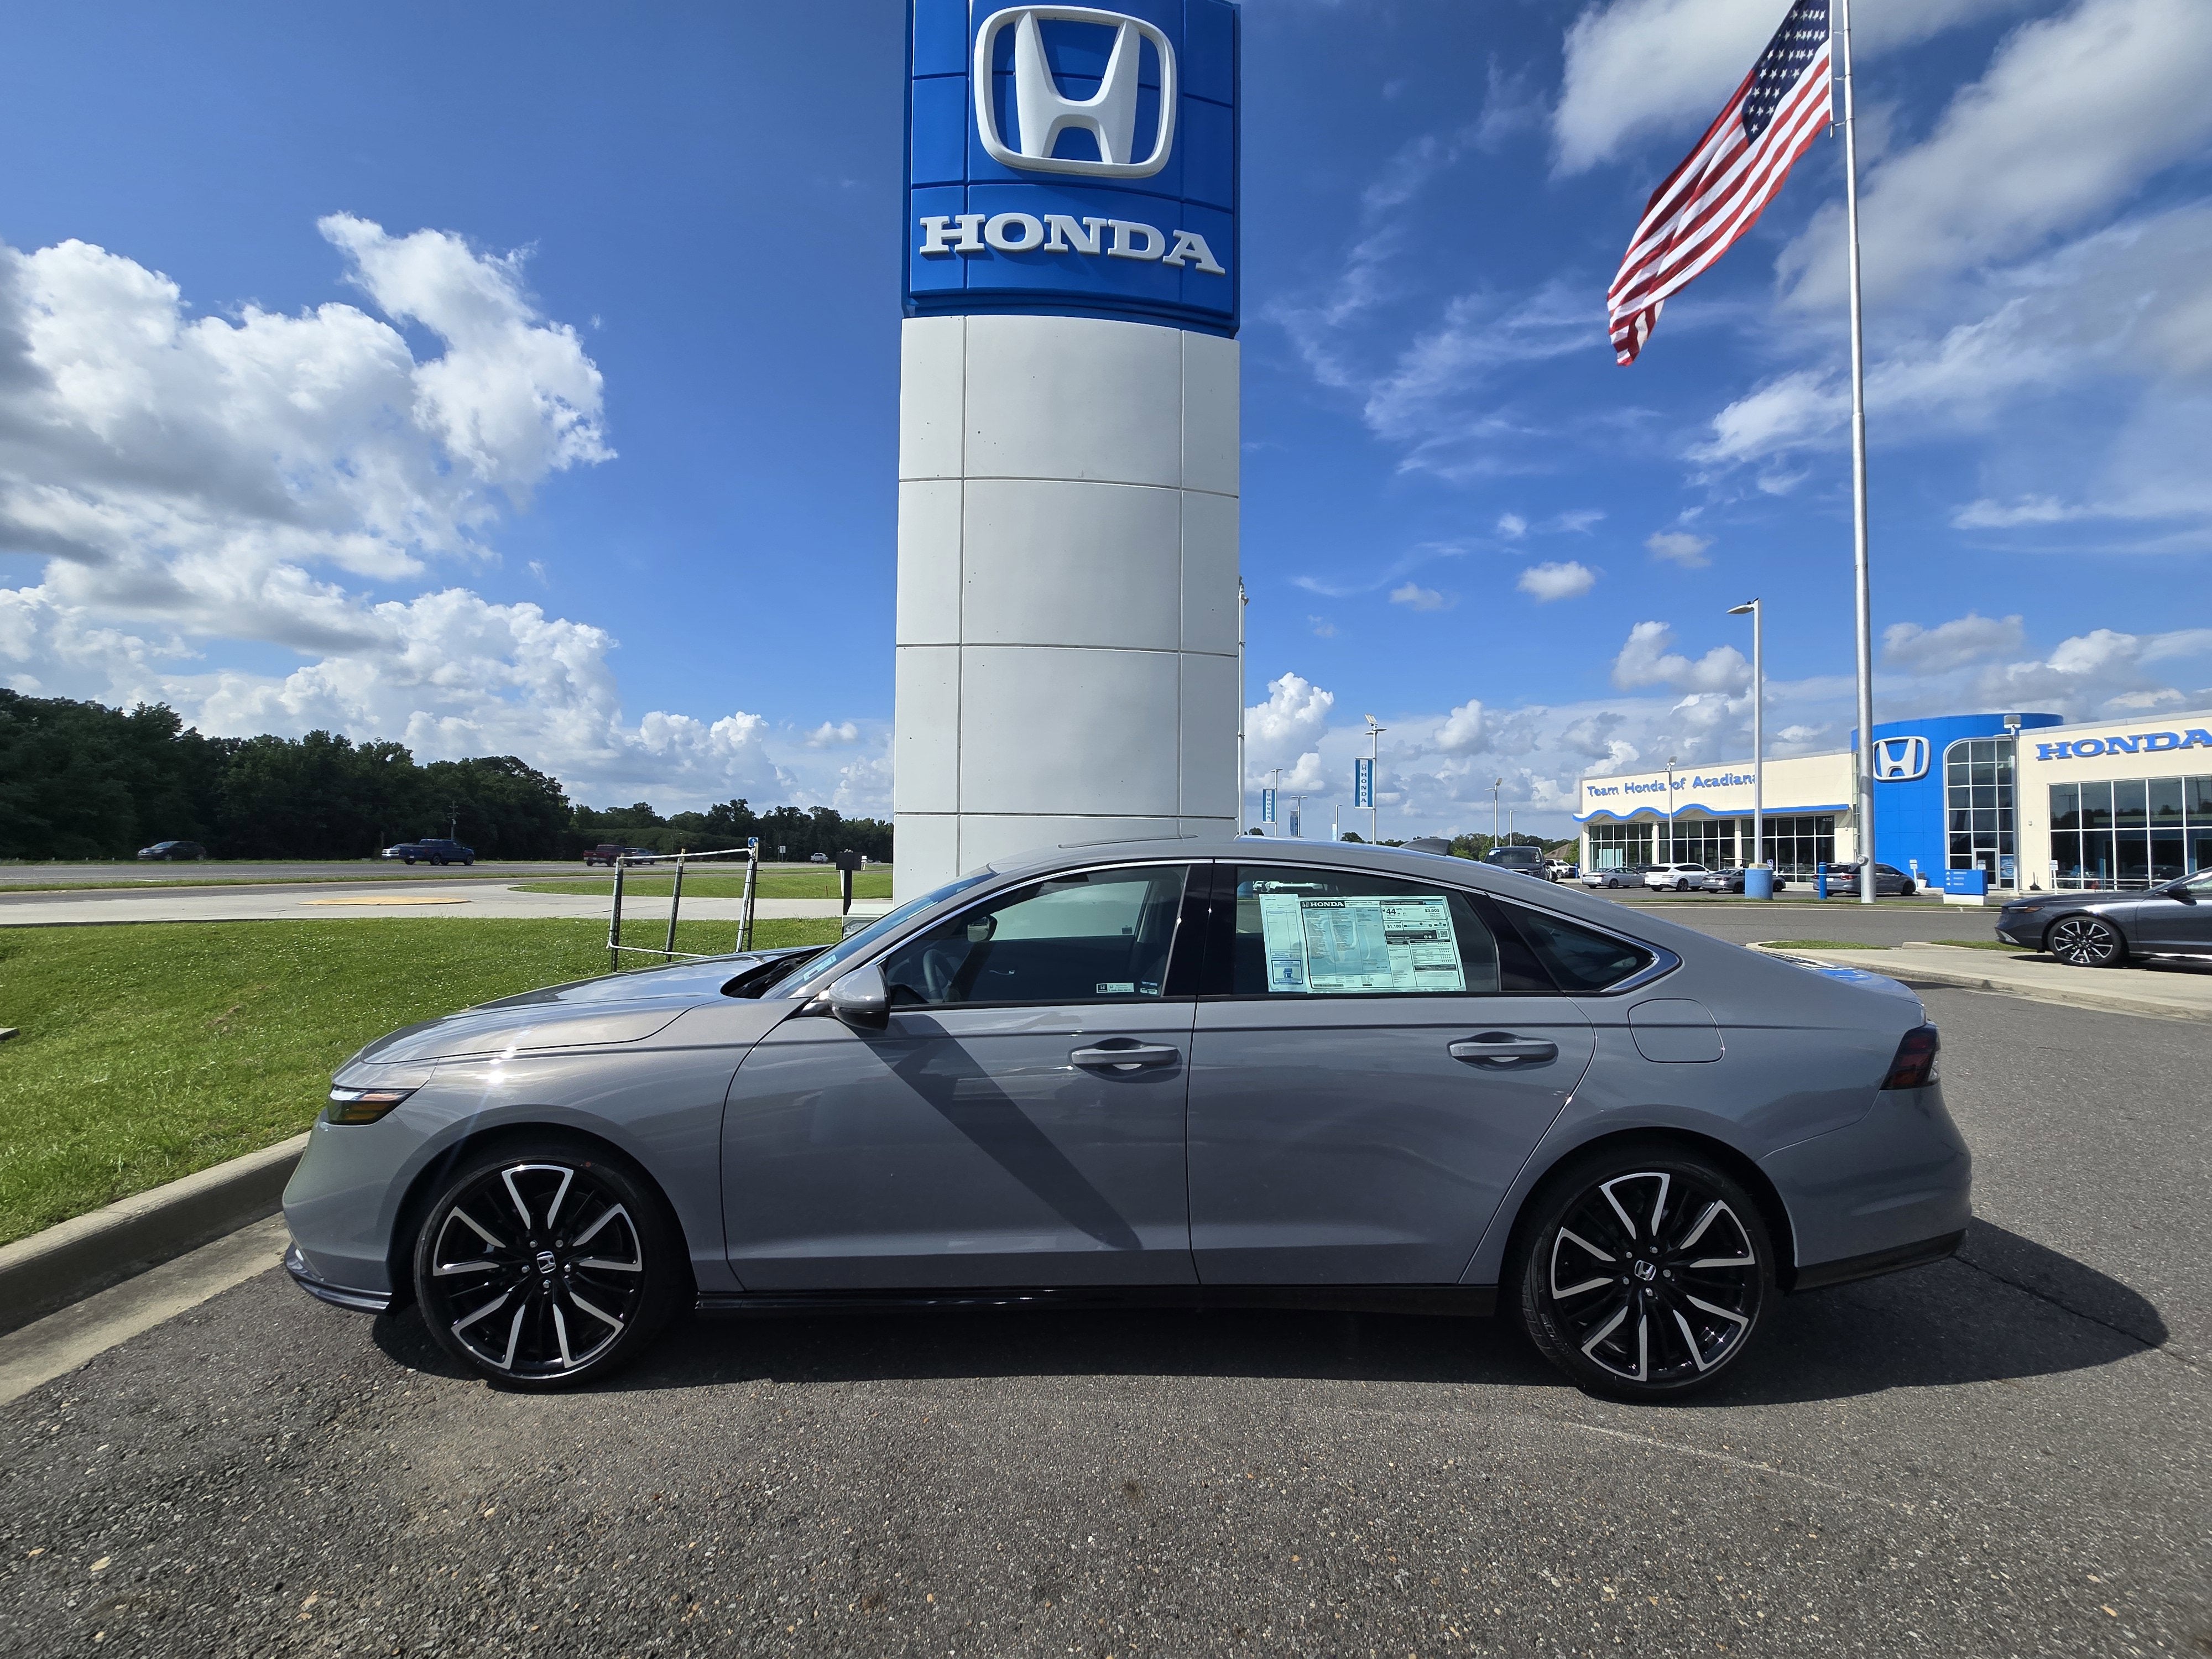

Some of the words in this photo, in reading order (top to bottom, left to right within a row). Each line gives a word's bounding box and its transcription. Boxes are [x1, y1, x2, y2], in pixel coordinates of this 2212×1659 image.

[919, 212, 1225, 275] HONDA
[2036, 728, 2212, 761] HONDA
[1587, 785, 1620, 797] Team
[1625, 780, 1667, 794] Honda
[1671, 777, 1687, 790] of
